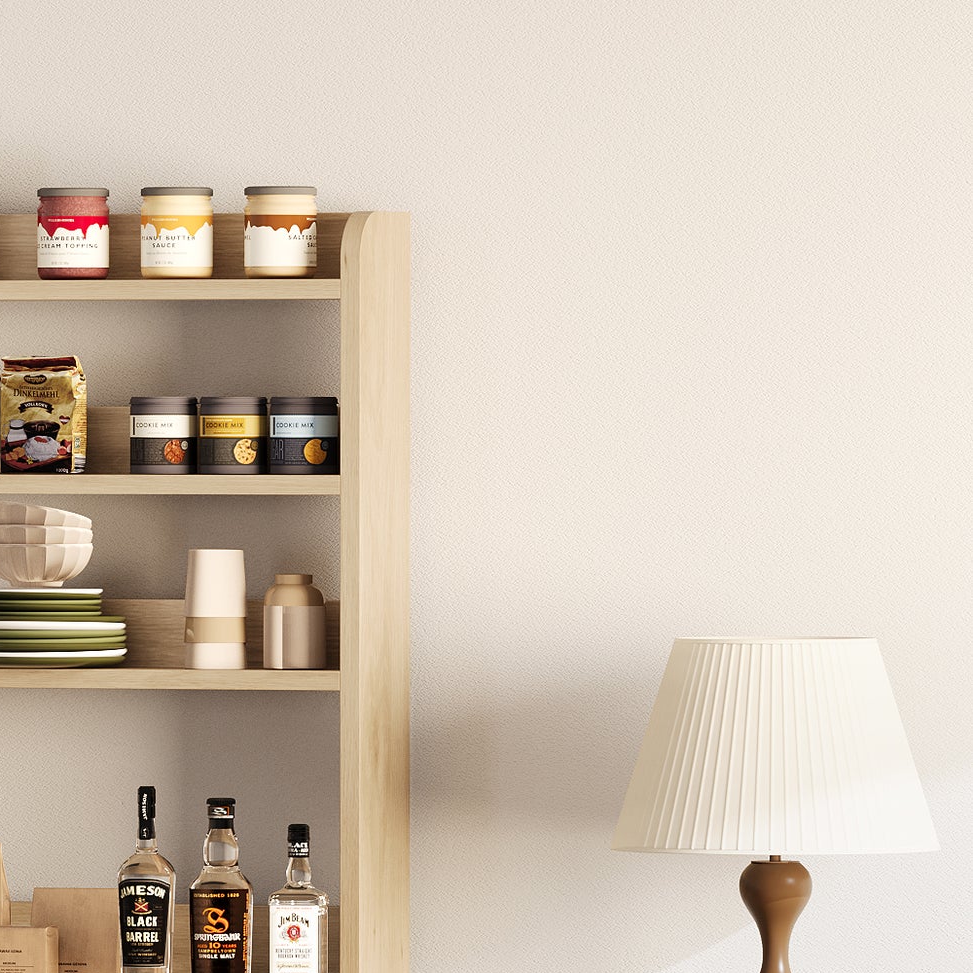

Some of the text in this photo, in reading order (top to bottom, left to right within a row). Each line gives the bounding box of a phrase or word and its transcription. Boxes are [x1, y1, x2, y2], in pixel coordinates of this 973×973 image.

[120, 884, 166, 899] JAMESON
[126, 916, 159, 927] BLACK
[126, 931, 160, 943] BARREL
